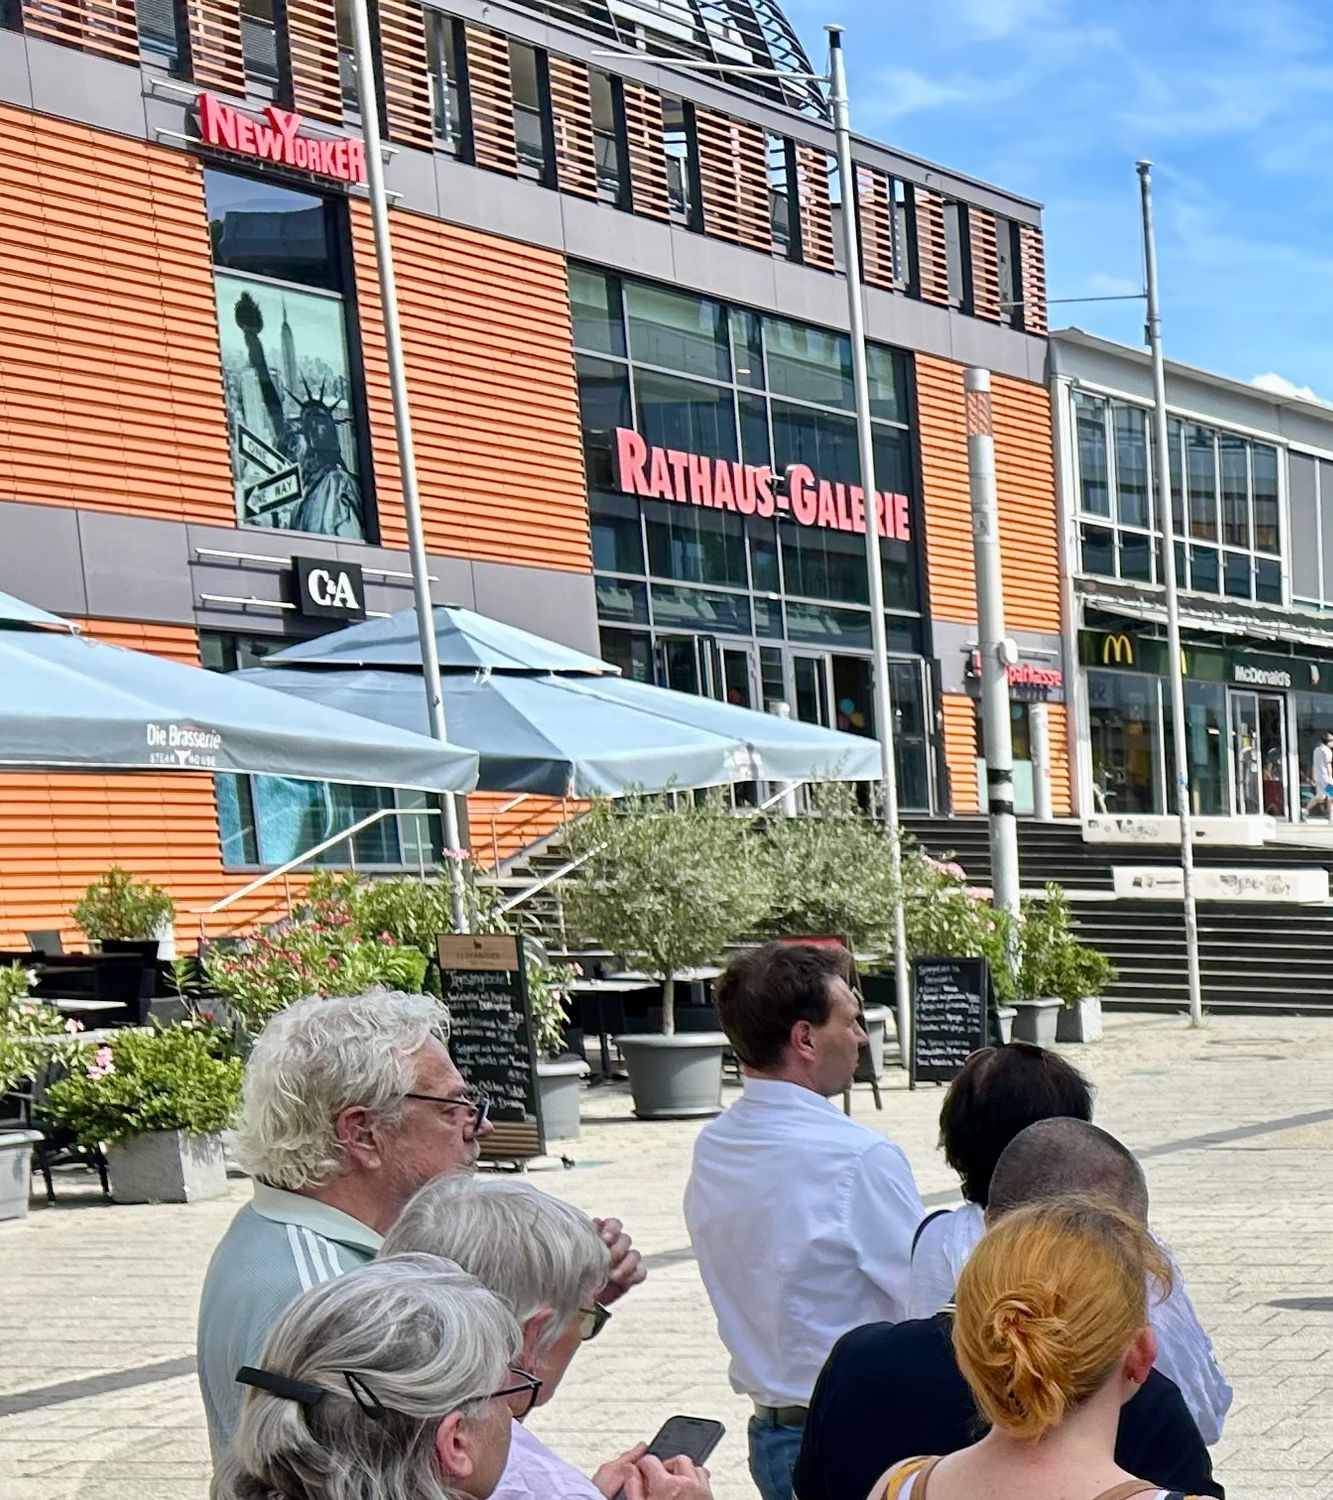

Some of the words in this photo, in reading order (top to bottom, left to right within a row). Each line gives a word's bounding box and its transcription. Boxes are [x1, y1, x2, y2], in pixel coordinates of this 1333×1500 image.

[274, 478, 293, 497] WAY
[308, 568, 360, 609] C&A
[1002, 664, 1062, 687] parkasse
[1234, 665, 1291, 687] McDonald's
[146, 723, 166, 746] Die
[169, 724, 222, 750] Brasserie
